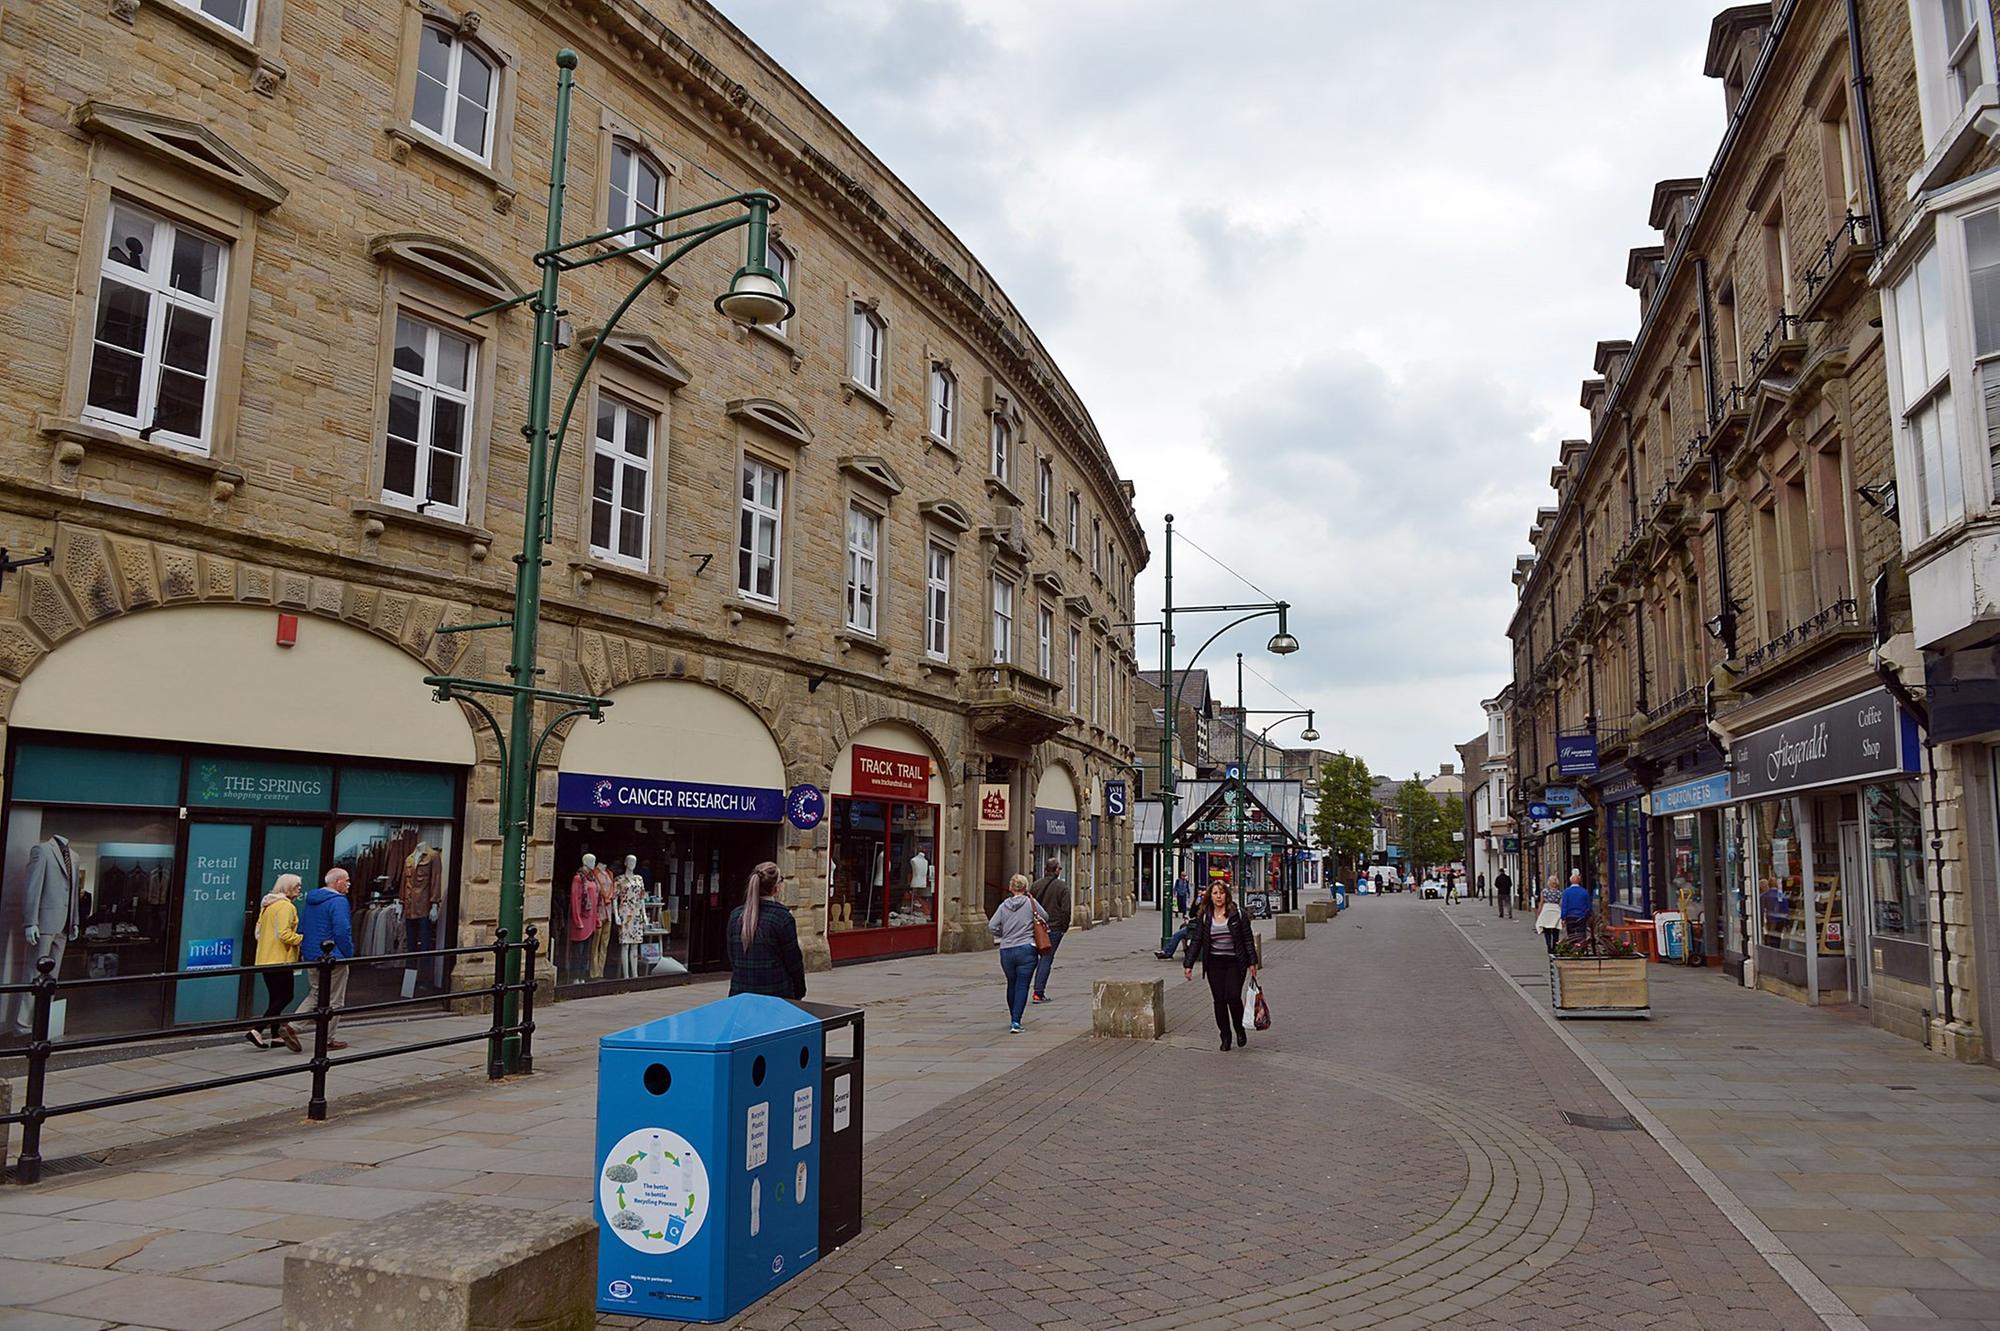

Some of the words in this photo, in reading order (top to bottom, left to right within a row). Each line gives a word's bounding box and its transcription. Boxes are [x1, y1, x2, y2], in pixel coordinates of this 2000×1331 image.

[1858, 706, 1882, 728] Coffee
[1766, 721, 1829, 782] Fitzgerald's
[1862, 737, 1881, 760] Shop
[860, 757, 893, 776] TRACK
[897, 763, 923, 780] TRAIL
[224, 776, 255, 791] THE
[259, 778, 321, 795] SPRINGS
[1109, 785, 1123, 793] WH
[1692, 784, 1711, 800] PETS
[223, 791, 262, 801] shopping
[618, 786, 673, 807] CANCER
[677, 791, 738, 811] RESEARCH
[740, 795, 757, 812] UK
[1109, 792, 1124, 815] S
[198, 856, 237, 868] Retail
[273, 858, 310, 870] Retail
[202, 872, 230, 885] Unit
[193, 889, 209, 901] To
[216, 889, 236, 901] Let
[190, 941, 232, 957] metis
[634, 1198, 657, 1207] Recycling
[659, 1199, 678, 1207] Process
